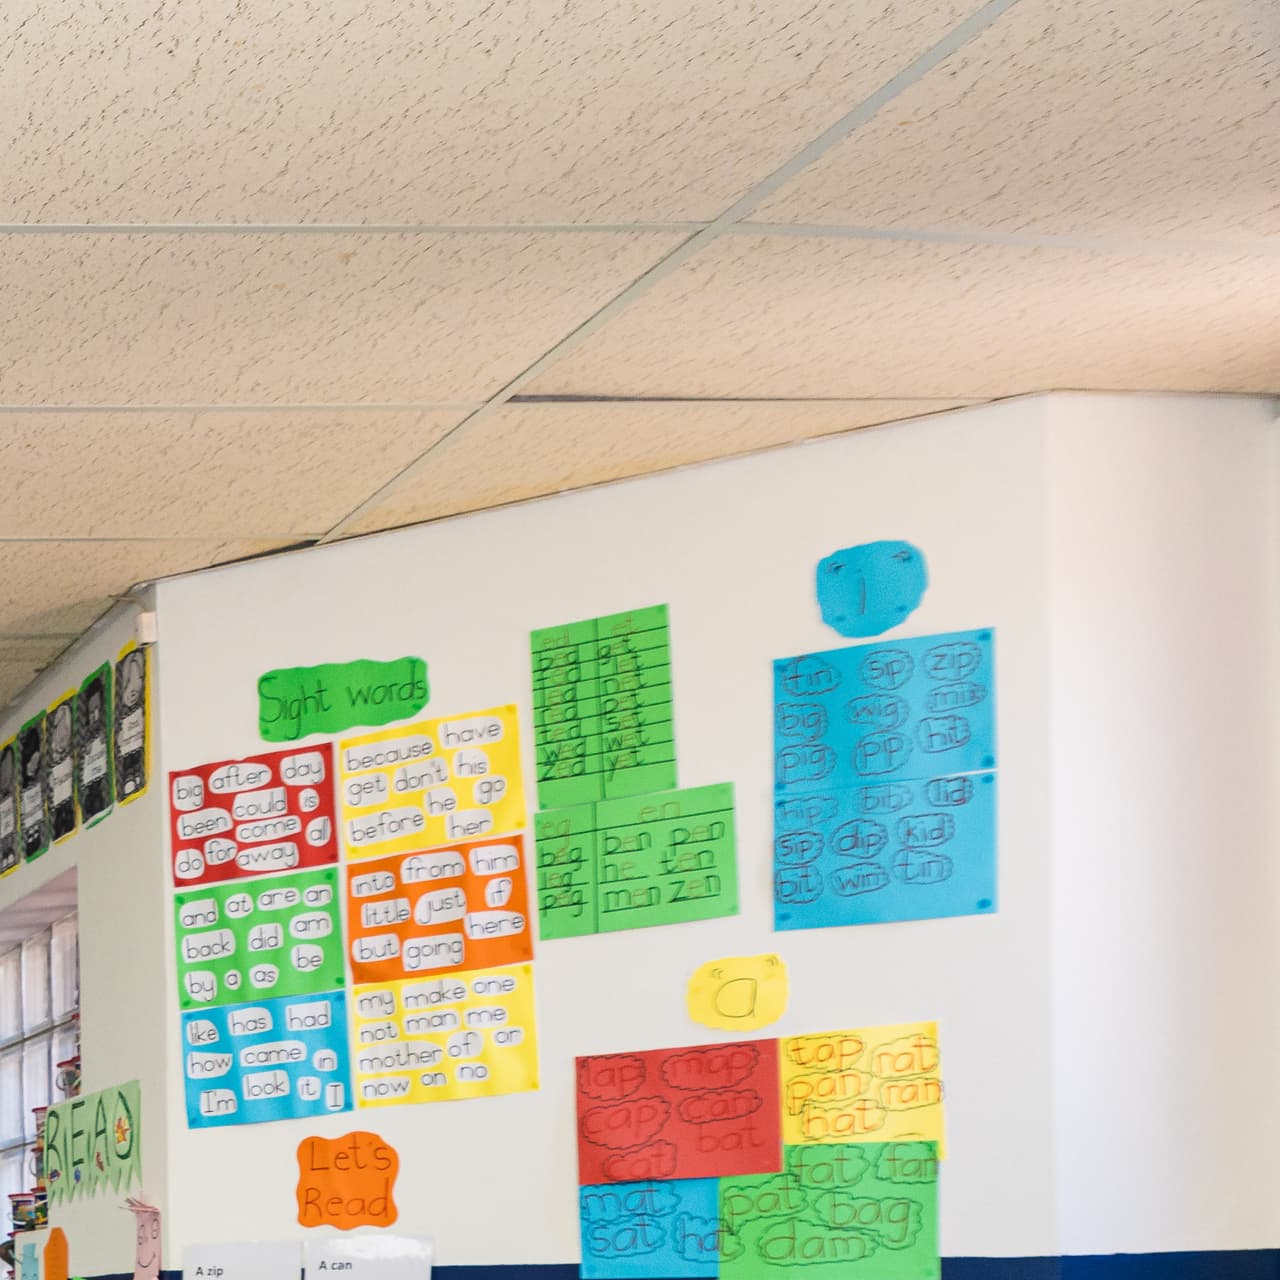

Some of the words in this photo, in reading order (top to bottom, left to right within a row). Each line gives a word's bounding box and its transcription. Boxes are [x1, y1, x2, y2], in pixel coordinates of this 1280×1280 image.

[258, 676, 331, 739] Sight
[346, 658, 428, 707] words
[444, 723, 501, 746] have
[346, 741, 433, 771] because
[212, 766, 268, 790] after
[284, 758, 322, 784] day
[395, 760, 448, 791] don't
[177, 779, 203, 807] big
[234, 788, 286, 818] could
[348, 777, 386, 806] get
[182, 816, 228, 837] been
[351, 811, 425, 841] before
[237, 844, 295, 867] away
[187, 932, 231, 959] back
[407, 940, 463, 969] going
[360, 1043, 443, 1072] mother
[247, 1072, 285, 1097] look
[310, 1134, 392, 1171] Let's
[304, 1177, 389, 1218] Read
[196, 1266, 204, 1276] A
[207, 1266, 224, 1278] zip
[318, 1261, 327, 1270] A
[331, 1262, 352, 1270] can
